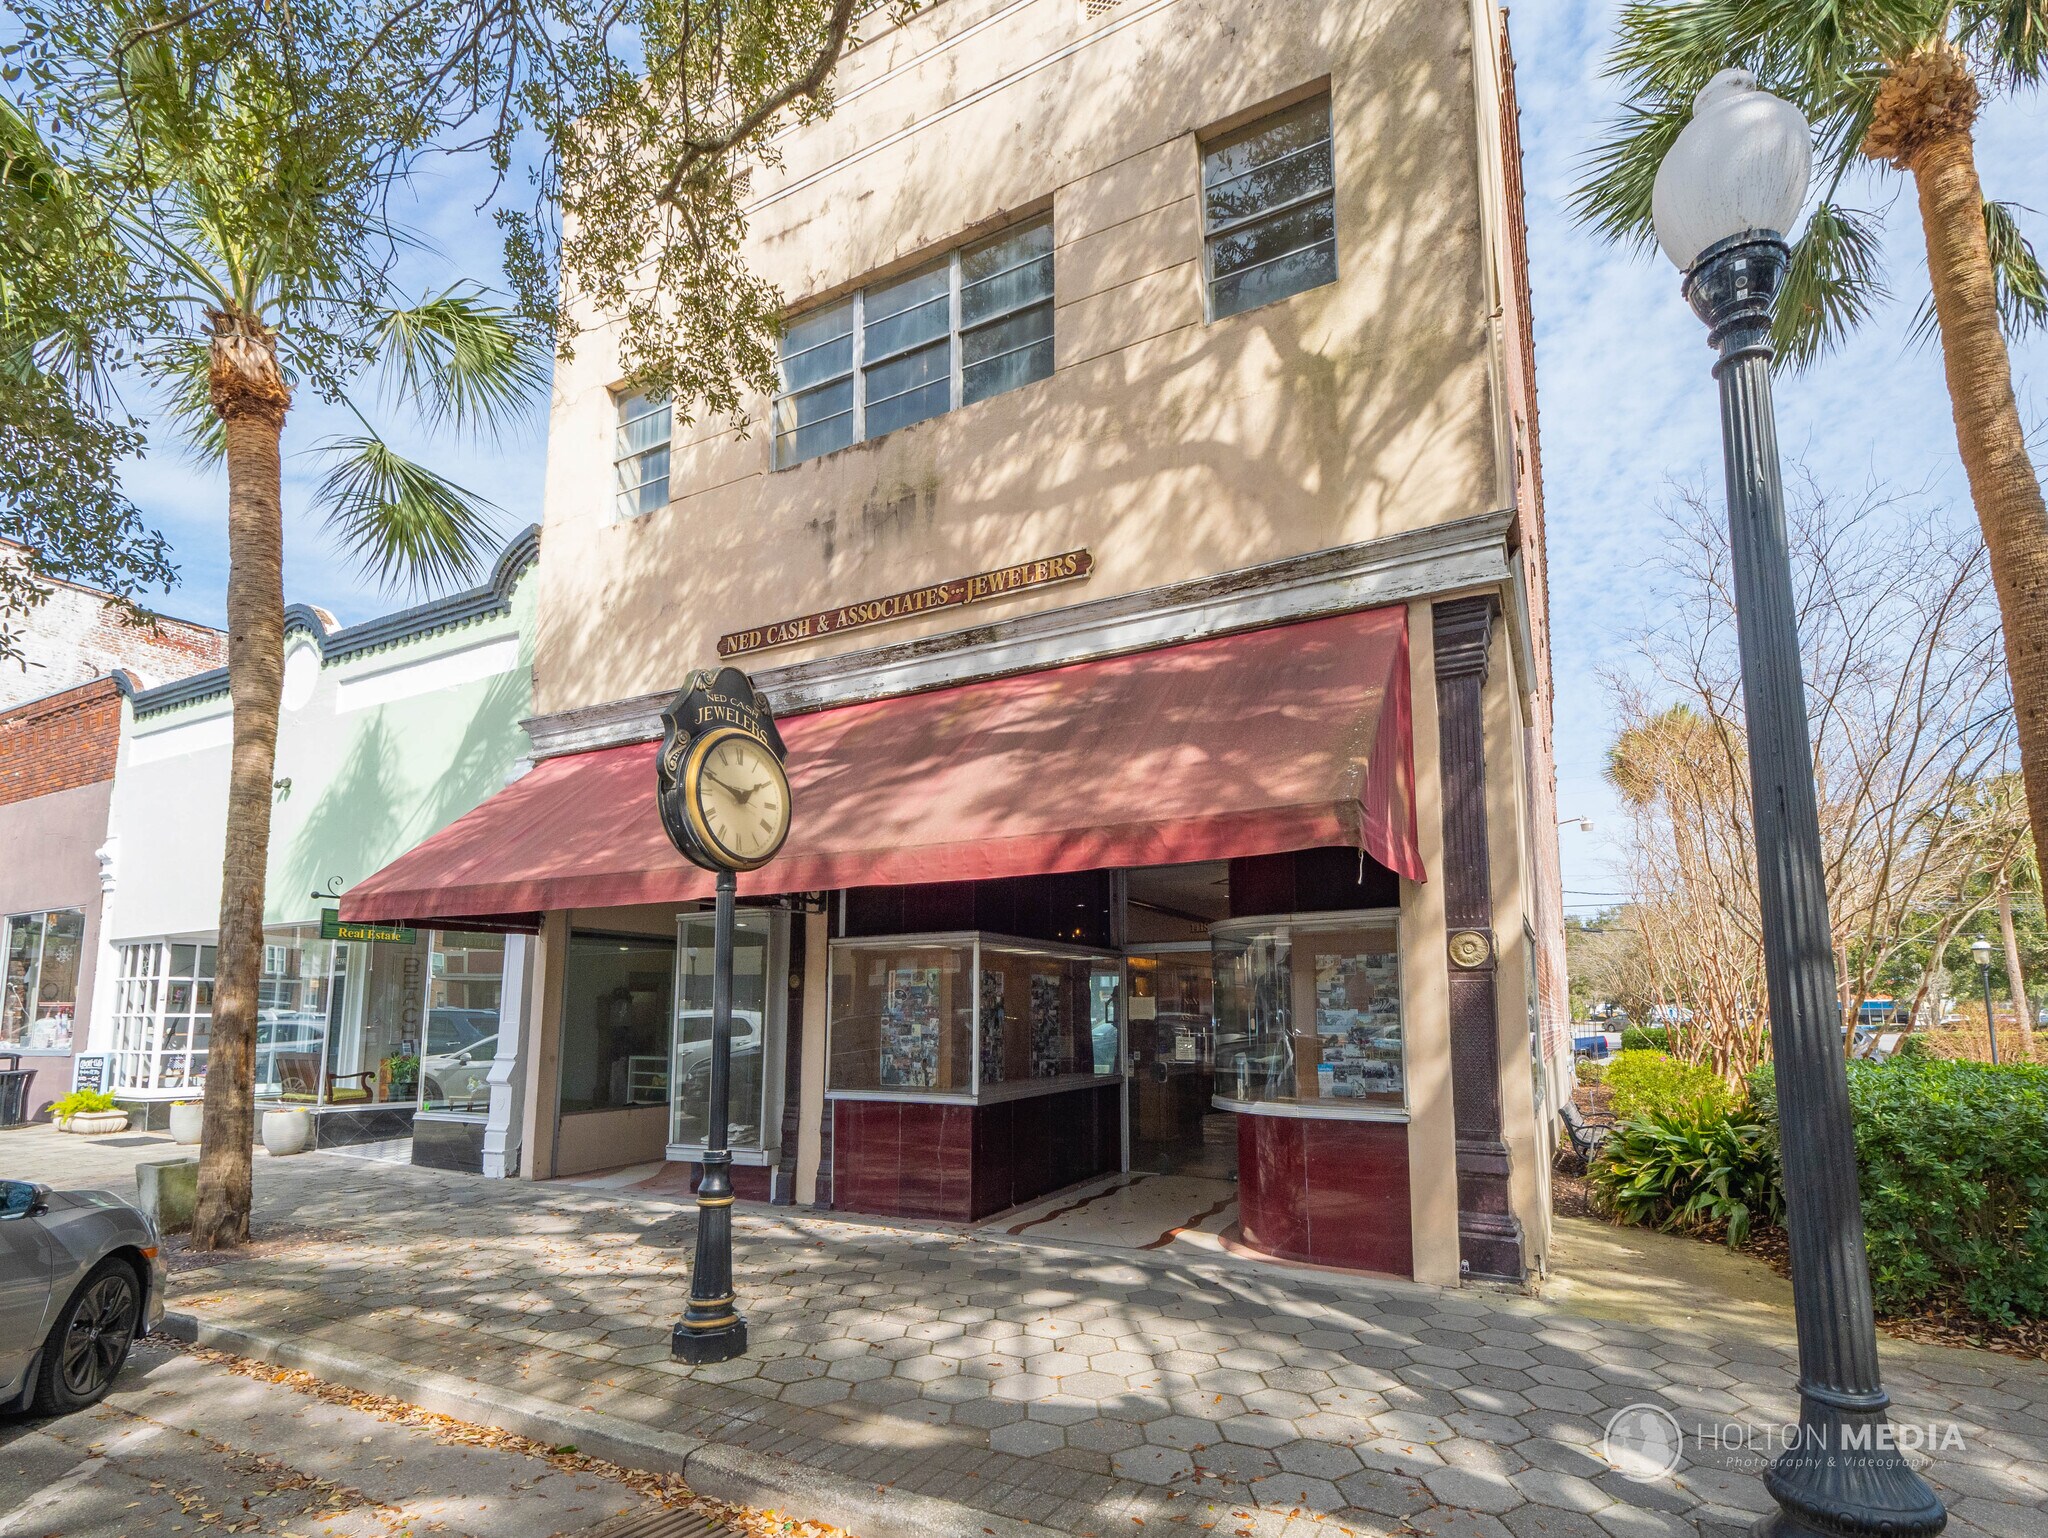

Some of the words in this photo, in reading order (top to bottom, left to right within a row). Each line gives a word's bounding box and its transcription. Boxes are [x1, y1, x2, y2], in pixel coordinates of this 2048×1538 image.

[726, 631, 762, 654] NED
[766, 618, 811, 644] CASH
[816, 614, 830, 633] &
[835, 585, 949, 629] ASSOCIATES
[964, 554, 1077, 604] JEWELERS
[706, 693, 727, 703] NED
[730, 697, 759, 719] CASH
[694, 705, 768, 745] JEWELERS
[338, 927, 364, 939] Real
[367, 929, 401, 941] Estate
